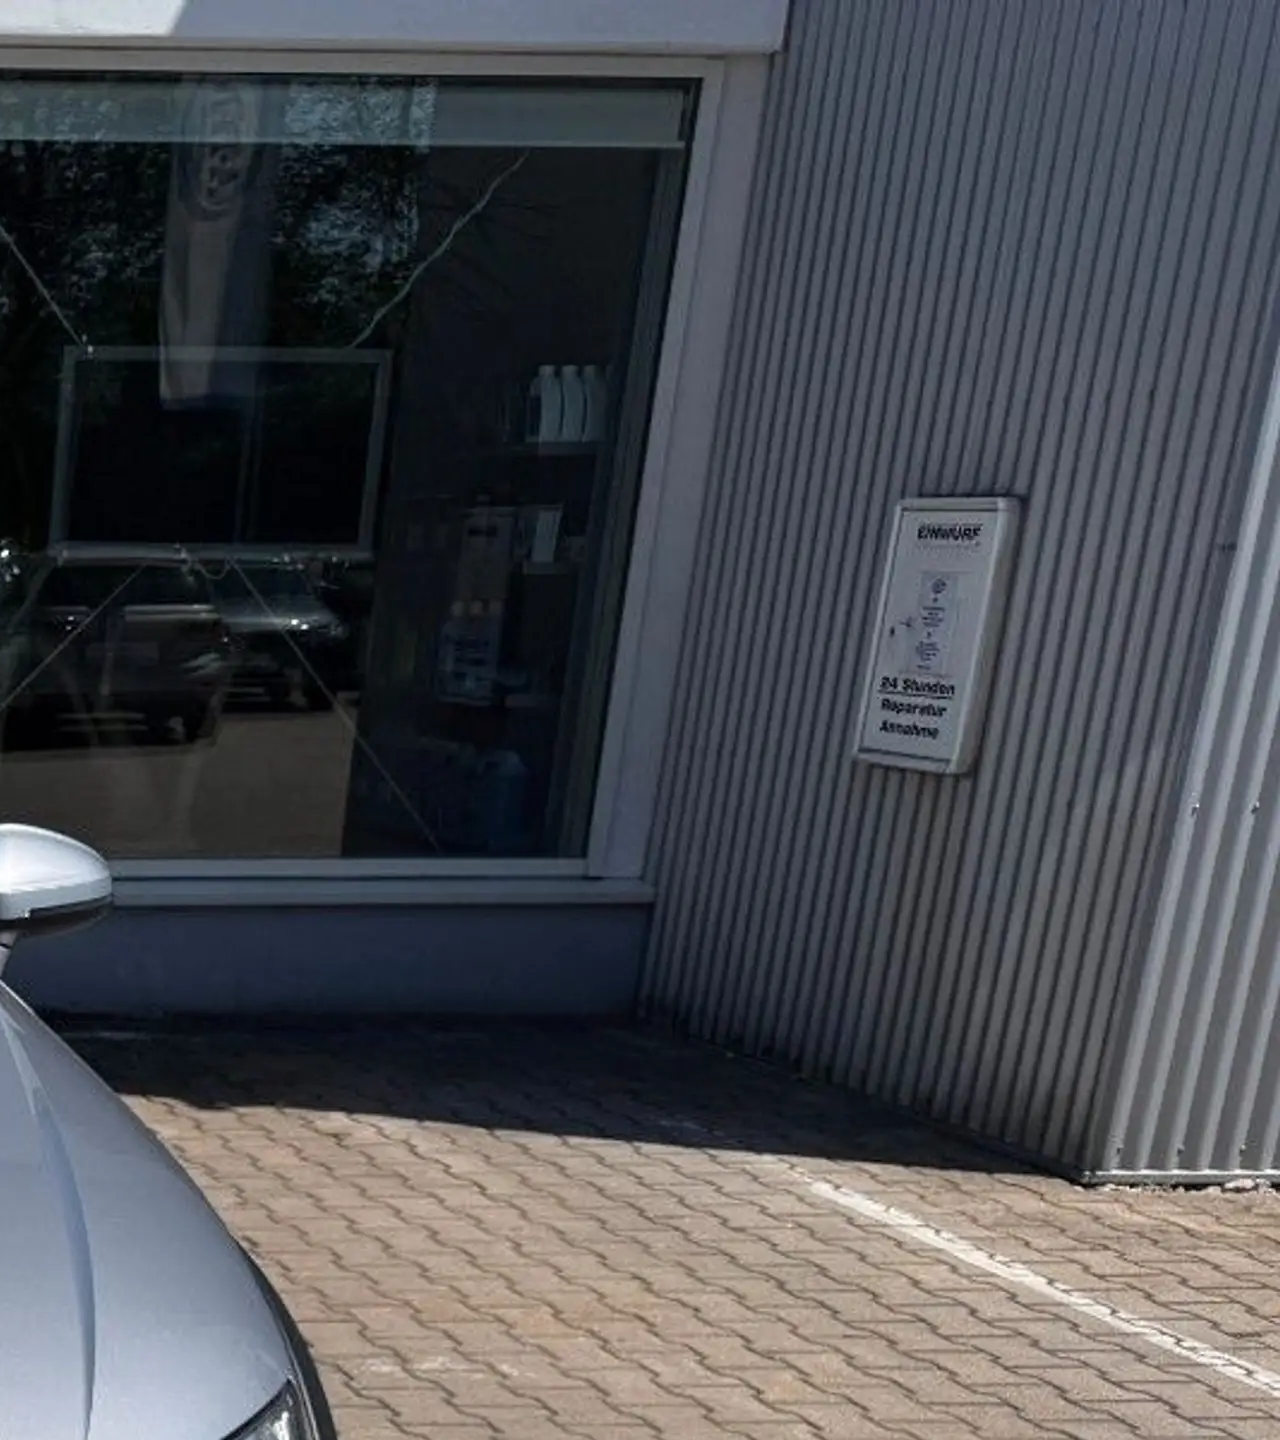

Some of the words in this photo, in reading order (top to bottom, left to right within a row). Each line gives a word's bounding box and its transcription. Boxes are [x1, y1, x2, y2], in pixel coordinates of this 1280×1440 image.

[917, 523, 983, 542] EINWURF
[880, 676, 897, 690] 24
[903, 677, 956, 695] Stunden
[880, 699, 947, 718] Reparatur
[880, 721, 940, 740] Annahme
